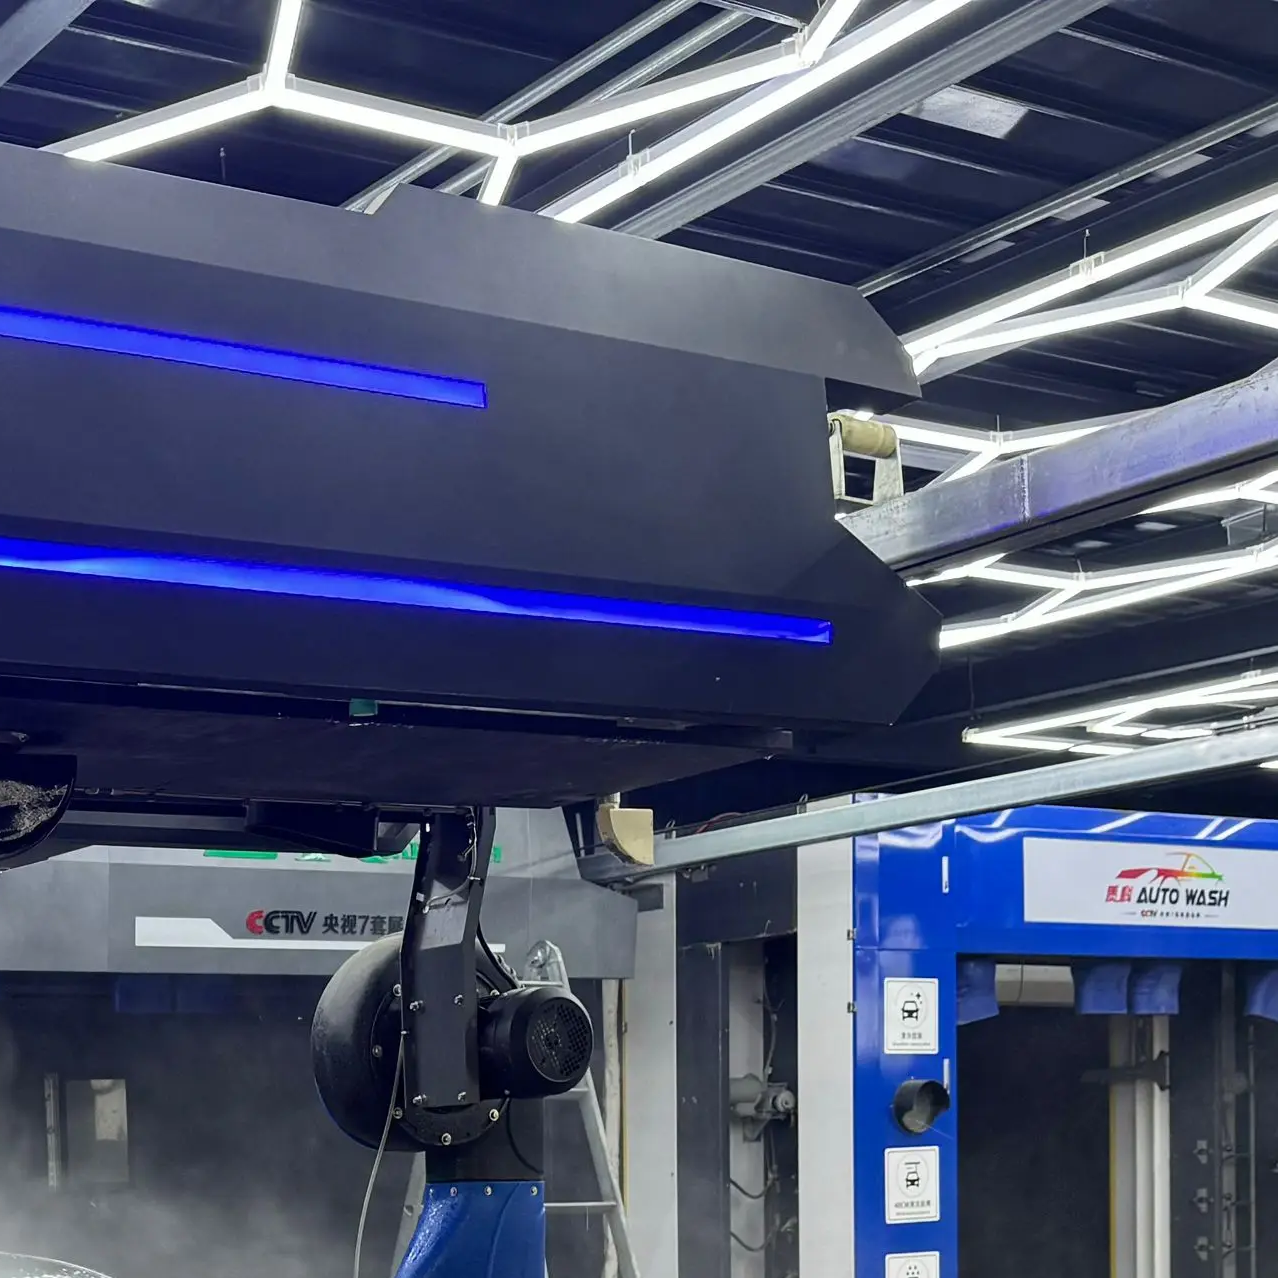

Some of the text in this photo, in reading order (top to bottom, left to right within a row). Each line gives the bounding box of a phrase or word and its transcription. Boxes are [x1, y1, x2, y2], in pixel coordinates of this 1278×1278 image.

[1136, 885, 1180, 905] AUTO
[1185, 888, 1230, 908] WASH
[245, 910, 317, 935] CCTV
